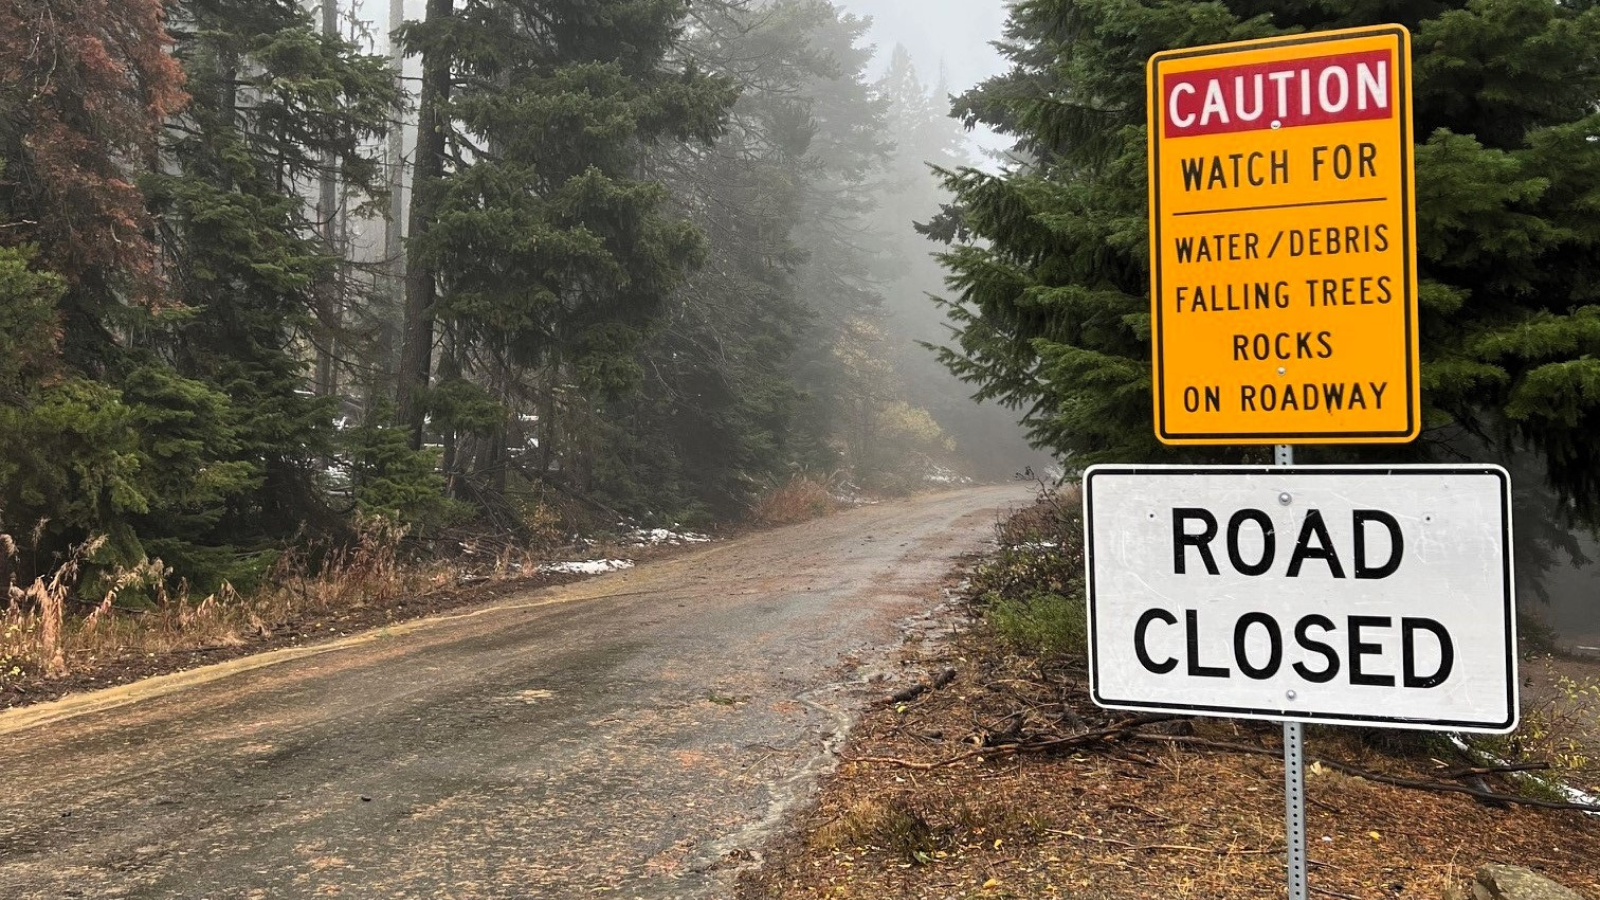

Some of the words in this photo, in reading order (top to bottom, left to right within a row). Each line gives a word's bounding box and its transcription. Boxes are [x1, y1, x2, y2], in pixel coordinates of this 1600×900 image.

[1168, 60, 1388, 128] CAUTION
[1181, 149, 1289, 192] WATCH
[1312, 142, 1377, 182] FOR
[1176, 281, 1289, 313] FALLING
[1306, 275, 1392, 307] TREES
[1233, 331, 1333, 361] ROCKS
[1184, 385, 1220, 413] ON
[1241, 382, 1388, 413] ROADWAY
[1171, 507, 1404, 580] ROAD
[1134, 608, 1454, 689] CLOSED
